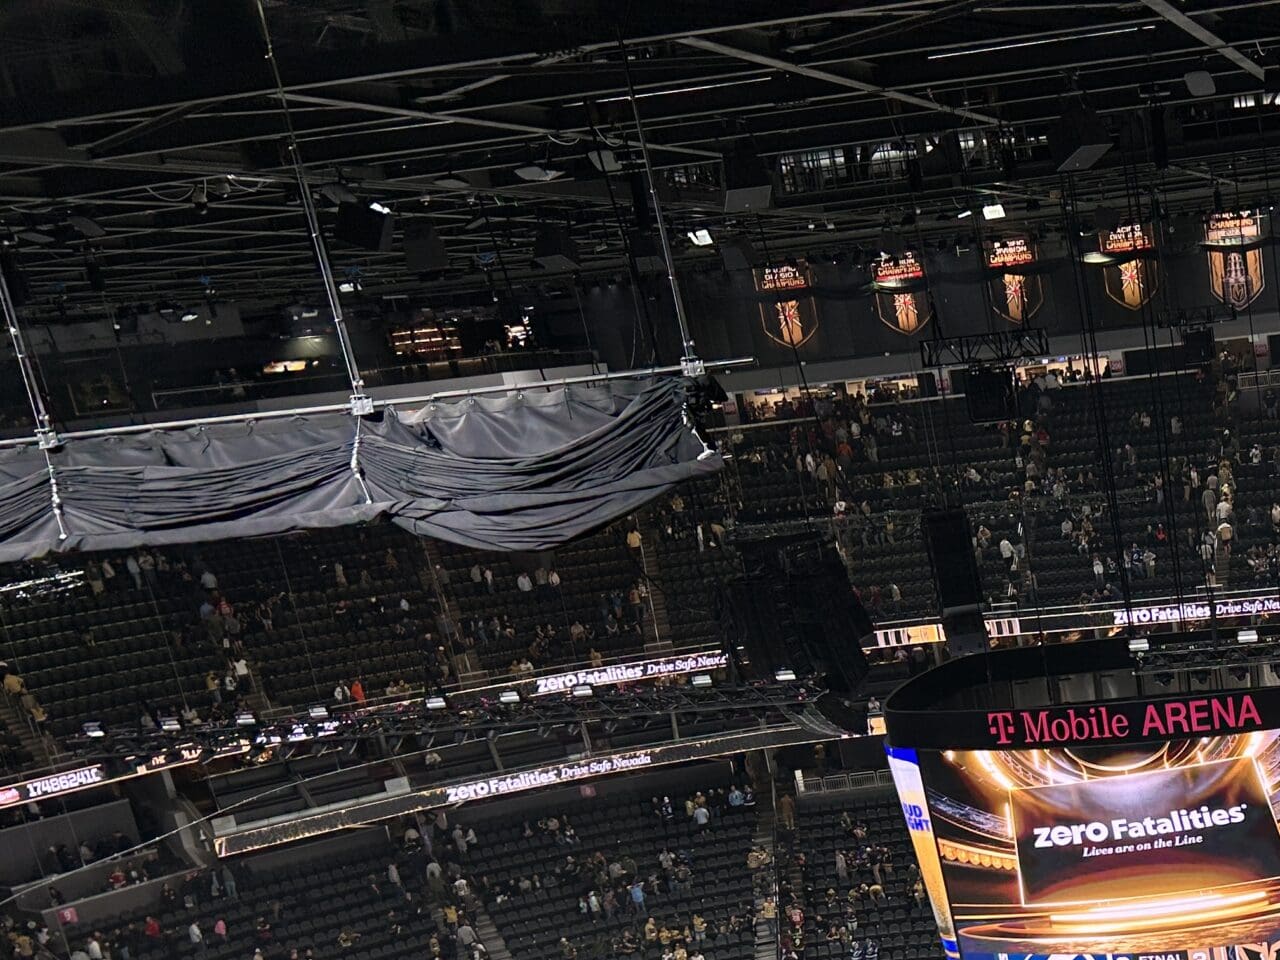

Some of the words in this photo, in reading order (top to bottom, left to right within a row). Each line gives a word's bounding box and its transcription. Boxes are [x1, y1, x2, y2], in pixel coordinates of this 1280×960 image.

[1151, 604, 1211, 621] Fatalities
[1216, 602, 1242, 615] Drive
[1242, 600, 1263, 612] Safe
[537, 673, 577, 693] zero
[579, 666, 643, 687] Fatalities
[647, 661, 674, 676] Drive
[675, 657, 697, 671] Safe
[1142, 695, 1262, 738] ARENA
[447, 782, 488, 801] zero
[490, 770, 557, 795] Fatalities
[561, 765, 588, 780] Drive
[590, 760, 612, 774] Safe
[613, 753, 651, 770] Nevada
[904, 804, 922, 817] UD
[908, 818, 930, 832] GHT
[1033, 822, 1108, 848] zero
[1112, 805, 1246, 841] Fatalities
[1082, 845, 1113, 858] Lives
[1115, 844, 1135, 855] are
[1136, 842, 1151, 852] on
[1154, 838, 1172, 850] the
[1175, 835, 1203, 848] Line
